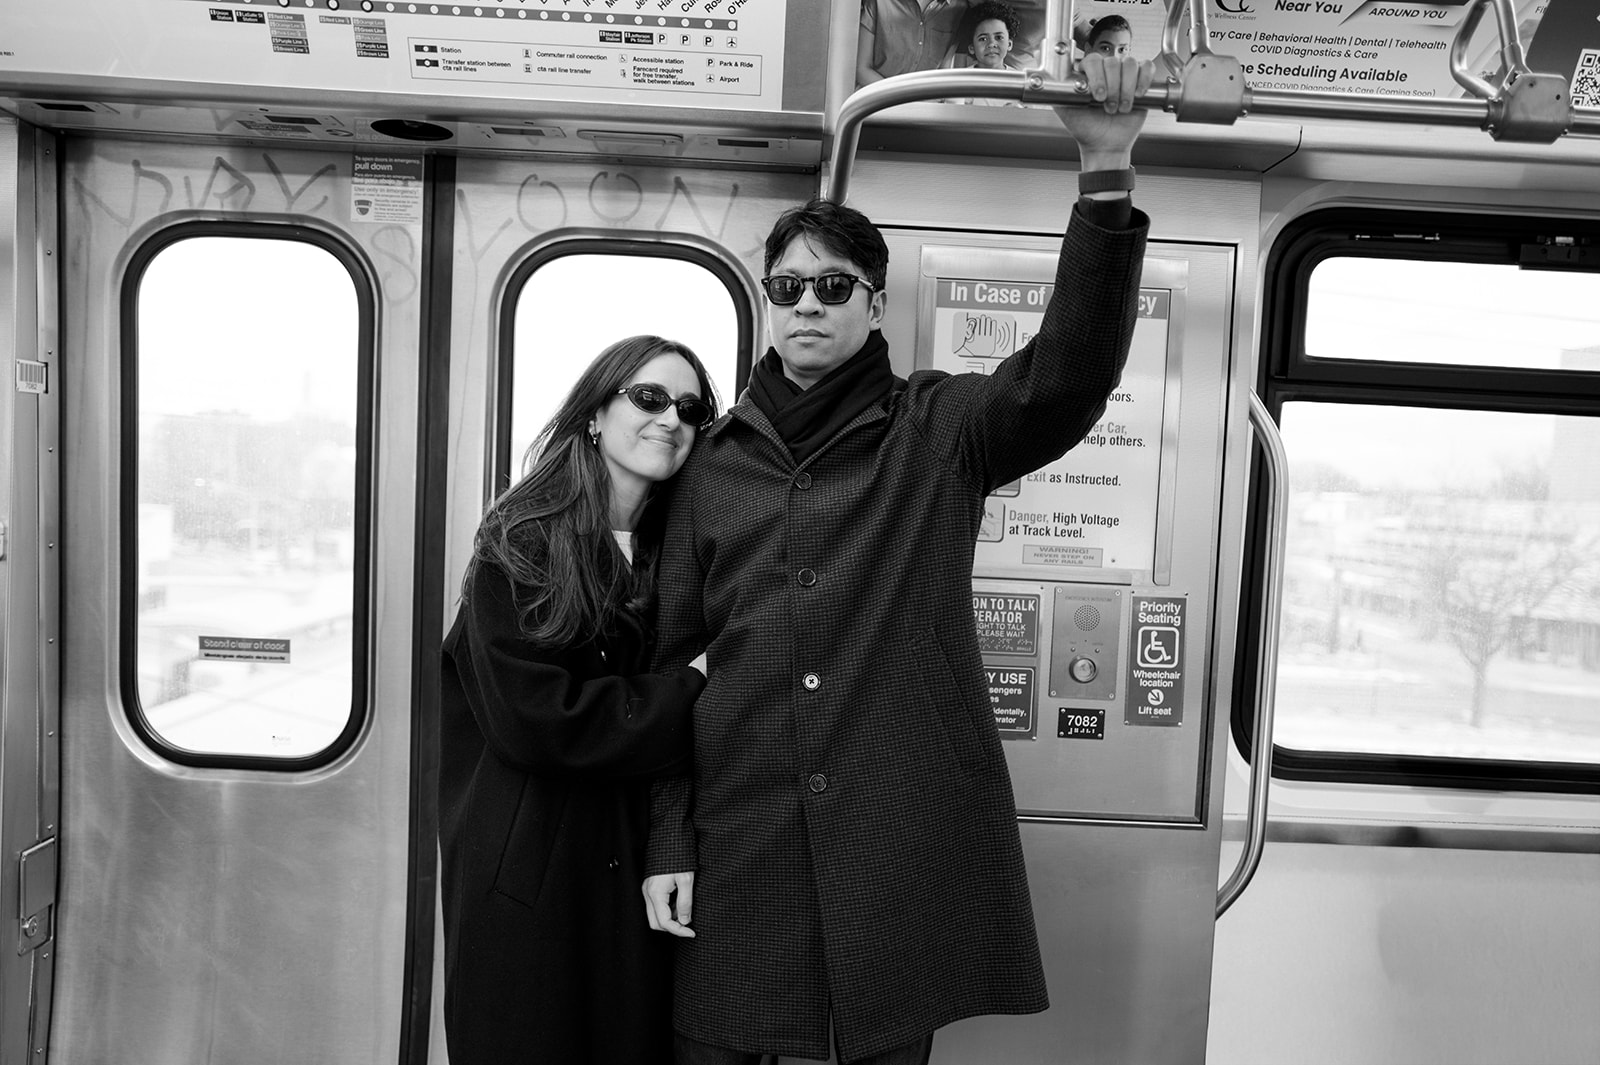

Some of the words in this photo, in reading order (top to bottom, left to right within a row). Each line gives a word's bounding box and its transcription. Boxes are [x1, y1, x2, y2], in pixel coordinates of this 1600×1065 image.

[1275, 0, 1311, 13] Near
[1315, 2, 1342, 14] You
[1368, 8, 1419, 18] AROUND
[1422, 10, 1448, 19] YOU
[1210, 31, 1226, 40] ary
[1228, 31, 1252, 40] Care
[1260, 32, 1312, 43] Behavioral
[1314, 35, 1346, 45] Health
[1354, 37, 1387, 47] Dental
[1396, 39, 1446, 50] Telehealth
[536, 51, 564, 59] Commuter
[1251, 44, 1282, 54] COVID
[1284, 46, 1342, 59] Diagnostics
[1344, 50, 1351, 58] &
[1354, 50, 1378, 60] Care
[633, 56, 663, 64] Accessible
[1257, 63, 1336, 82] Scheduling
[1340, 67, 1408, 82] Available
[720, 76, 740, 84] Airport
[1274, 82, 1299, 90] COVID
[1300, 83, 1345, 93] Diagnostics
[1412, 89, 1436, 97] Soon)
[355, 162, 369, 171] pull
[371, 162, 392, 170] down
[950, 282, 968, 302] In
[974, 283, 1021, 306] Case
[1027, 286, 1046, 306] of
[1138, 295, 1158, 316] cy
[1108, 392, 1134, 403] oors.
[1093, 423, 1104, 433] er
[1107, 422, 1128, 435] Car,
[1084, 435, 1106, 446] help
[1110, 435, 1146, 448] others.
[1027, 471, 1046, 482] Exit
[1050, 474, 1062, 483] as
[1066, 473, 1122, 486] Instructed.
[1009, 510, 1048, 525] Danger,
[1054, 512, 1077, 526] High
[1080, 513, 1120, 528] Voltage
[1009, 525, 1019, 535] at
[1022, 525, 1051, 537] Track
[1054, 526, 1086, 538] Level.
[1040, 546, 1089, 554] WARNING!
[990, 598, 1004, 610] TO
[1008, 599, 1036, 612] TALK
[1140, 601, 1181, 615] Priority
[976, 622, 994, 630] IGHT
[1138, 612, 1181, 627] Seating
[1006, 630, 1024, 638] WAIT
[987, 672, 996, 684] Y
[1000, 672, 1026, 685] USE
[1133, 669, 1181, 680] Wheelchair
[1140, 678, 1174, 688] location
[989, 687, 1022, 696] sengers
[1138, 706, 1152, 715] Lift
[1154, 707, 1172, 716] seat
[1068, 715, 1098, 728] 7082
